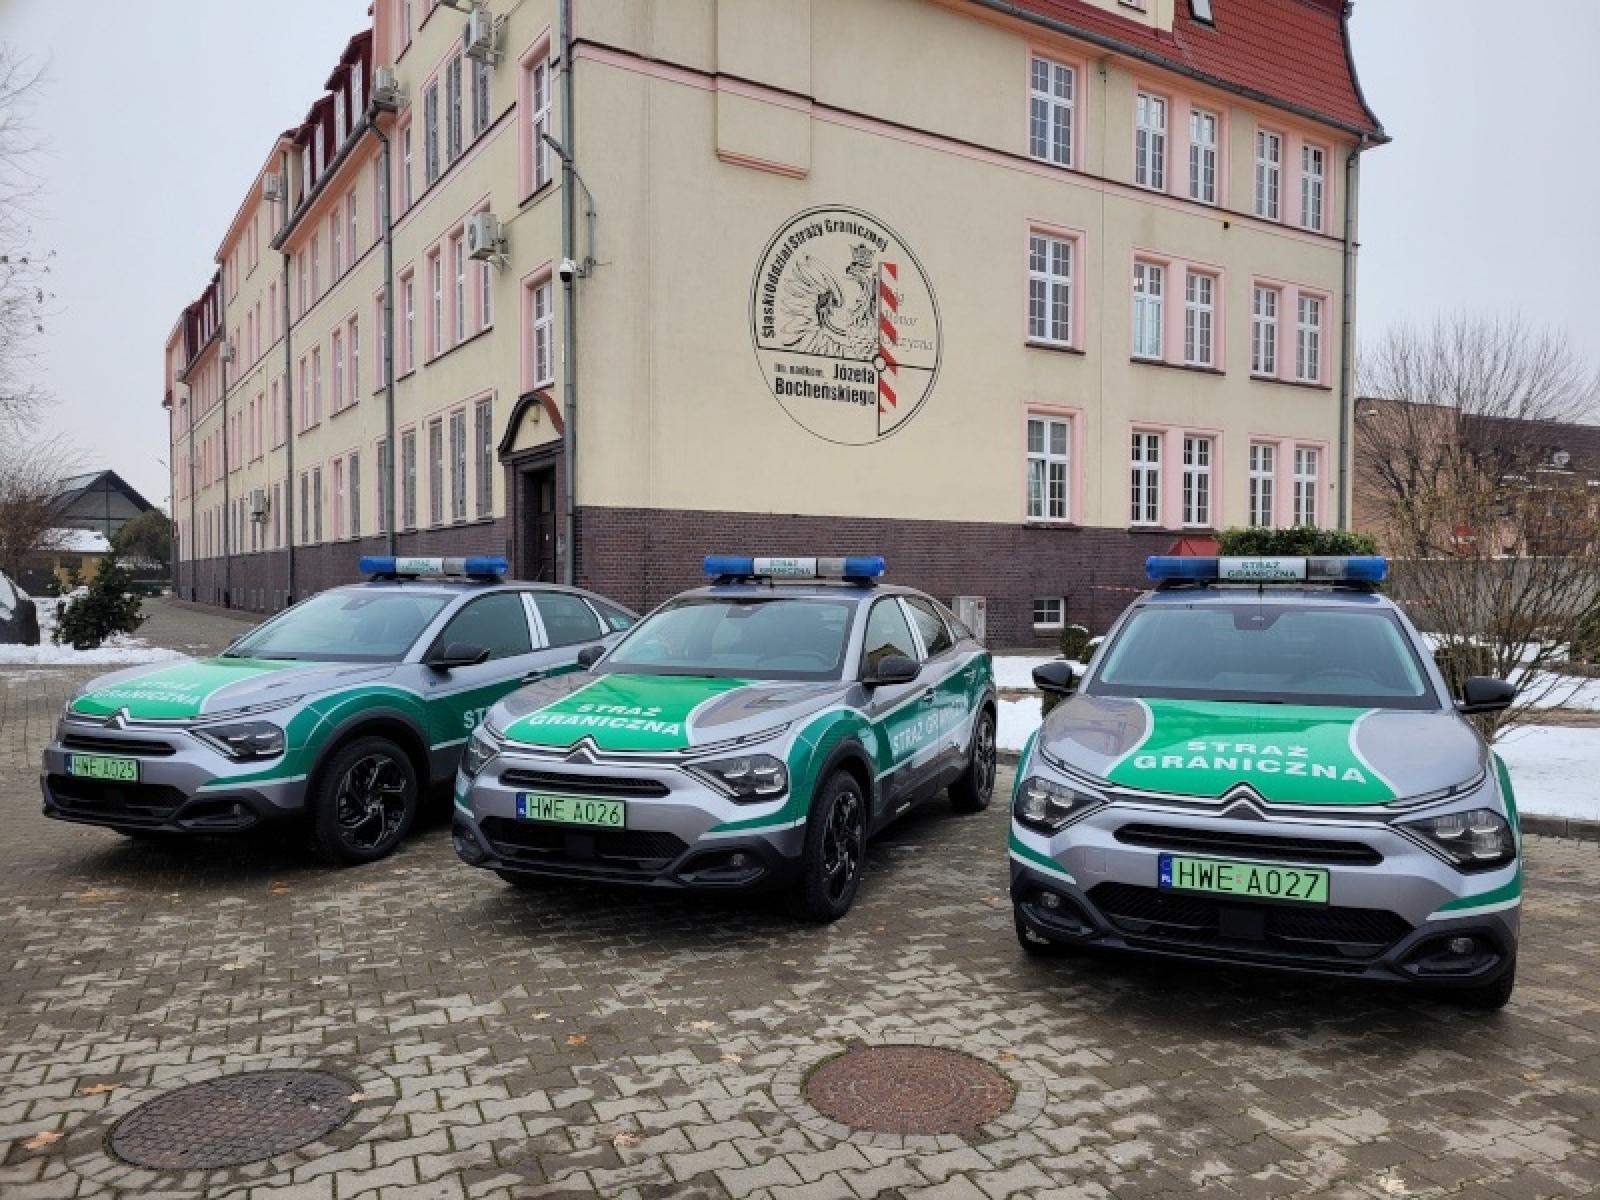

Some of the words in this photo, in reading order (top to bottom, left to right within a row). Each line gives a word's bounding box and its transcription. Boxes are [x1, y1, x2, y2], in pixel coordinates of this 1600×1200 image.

[833, 363, 875, 385] Józefa
[775, 377, 876, 406] Bocheńskiego
[529, 714, 681, 737] GRANICZNA
[1133, 755, 1367, 785] GRANICZNA
[530, 797, 565, 820] HWE
[574, 801, 621, 825] A026
[1178, 861, 1233, 891] HWE
[1247, 869, 1321, 900] A027
